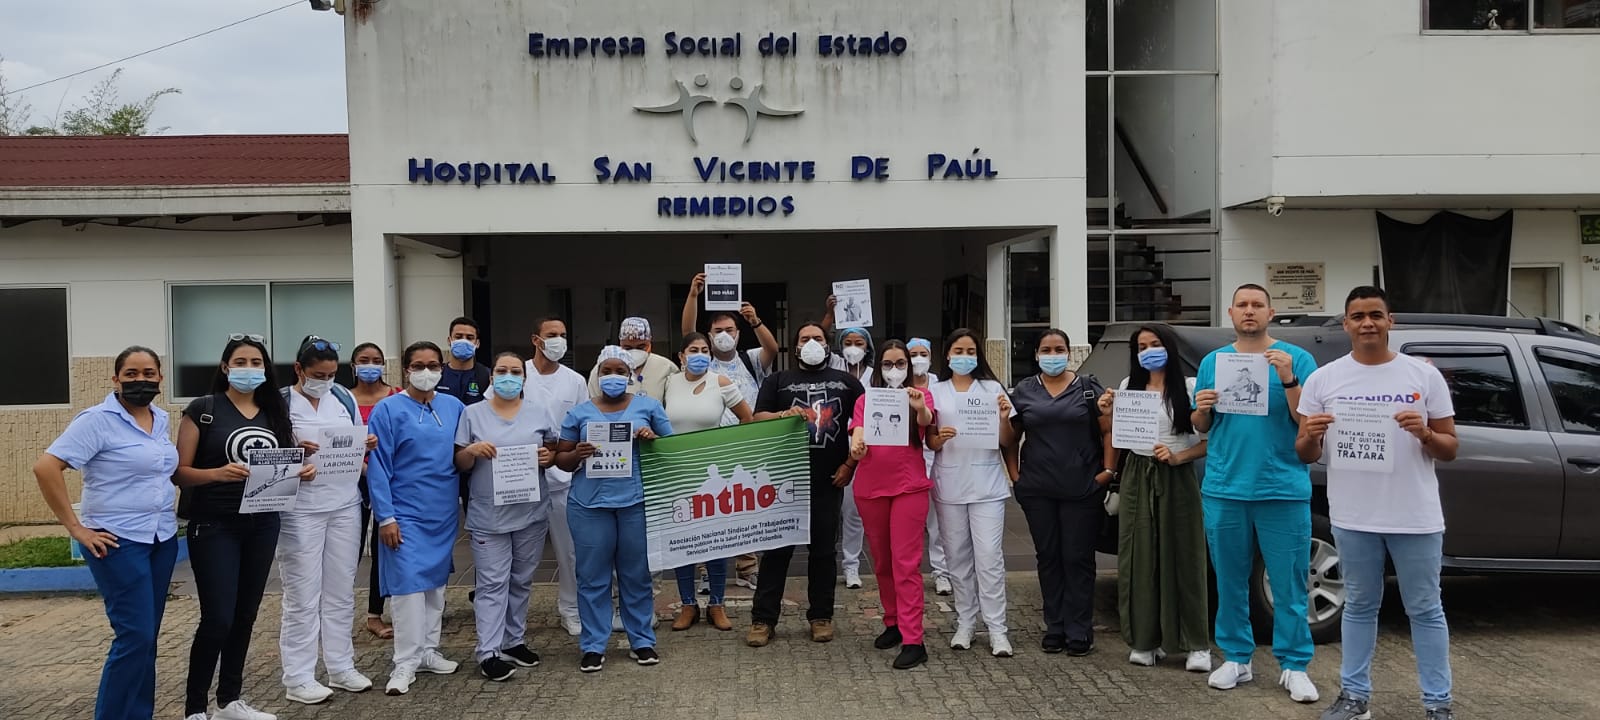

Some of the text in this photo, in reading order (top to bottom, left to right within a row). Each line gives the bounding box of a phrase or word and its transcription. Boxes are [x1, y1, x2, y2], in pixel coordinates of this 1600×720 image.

[529, 32, 908, 58] Empresa Social del Estado
[594, 157, 652, 181] SAN
[694, 157, 815, 182] VICENTE
[852, 157, 889, 179] DE
[928, 148, 998, 179] PAÚL
[658, 196, 795, 216] REMEDIOS
[967, 398, 981, 406] NO
[1337, 394, 1416, 404] NIDAD
[1337, 441, 1385, 452] QUE YO TE
[1337, 449, 1385, 461] TRATARA
[323, 460, 355, 468] LABORAL
[672, 479, 795, 523] anthoc
[669, 535, 701, 545] Asociación
[702, 530, 726, 540] Nacional
[727, 525, 750, 535] Sindical
[758, 518, 795, 529] Trabajadores
[709, 539, 751, 551] Complementarios
